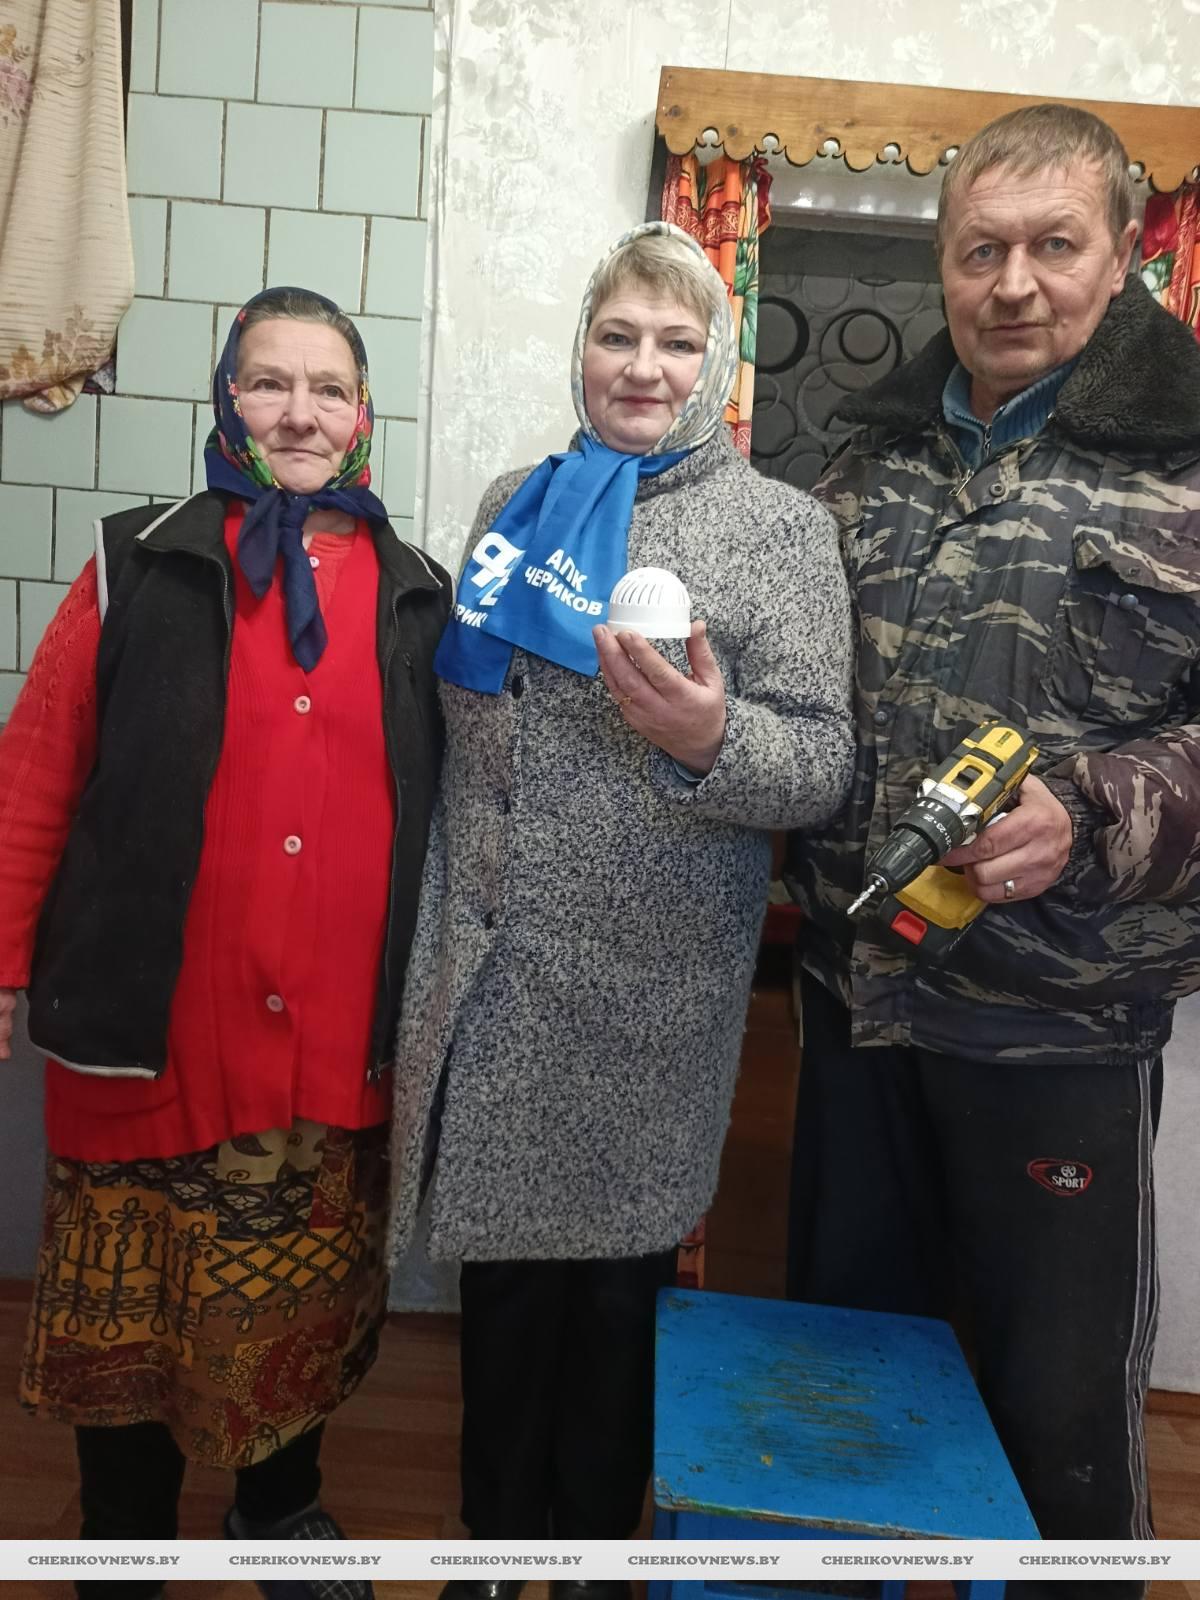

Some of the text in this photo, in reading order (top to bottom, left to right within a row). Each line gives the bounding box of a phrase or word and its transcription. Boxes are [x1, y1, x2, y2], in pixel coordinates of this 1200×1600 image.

[545, 548, 588, 593] АПК
[525, 566, 604, 616] ЧЕРИКОВ
[455, 604, 488, 627] РИК
[1052, 1175, 1085, 1188] SPORT
